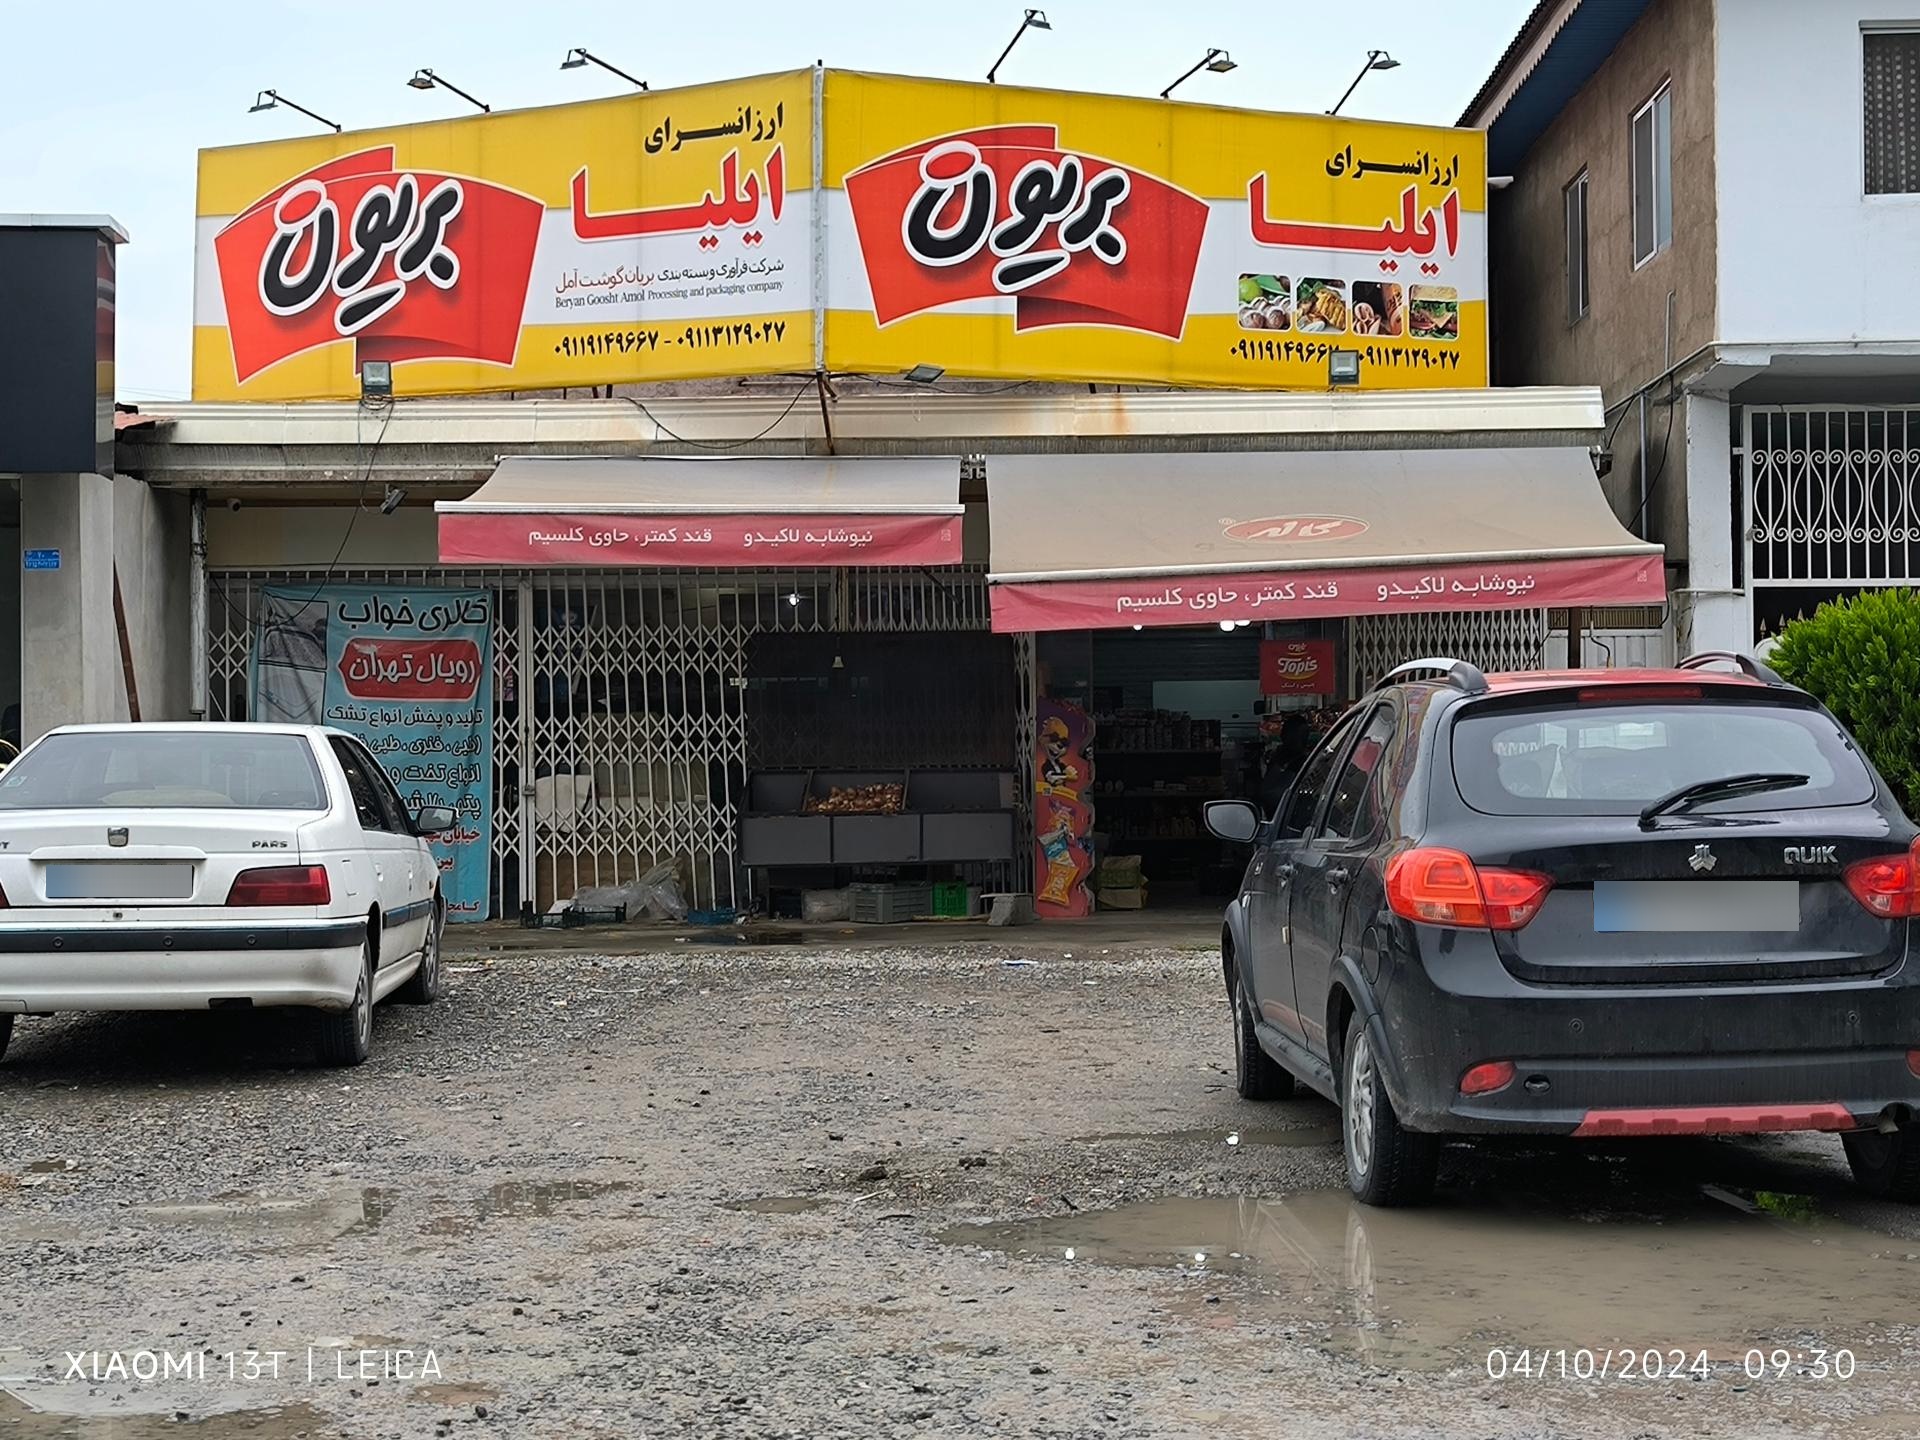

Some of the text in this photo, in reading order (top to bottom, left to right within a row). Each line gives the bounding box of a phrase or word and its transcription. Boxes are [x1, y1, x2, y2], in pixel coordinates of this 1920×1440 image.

[571, 143, 787, 250] ایلیا
[1247, 170, 1461, 275] ایلیا
[624, 265, 655, 287] بریان
[716, 257, 748, 279] فرآوری
[749, 257, 785, 274] شرکت
[555, 268, 579, 293] آمل
[579, 265, 625, 290] گوشت
[555, 279, 784, 310] Beryan Goosht Amol Processing and packaging company
[554, 329, 659, 357] ۰۹۱۱۹۱۴۹۶۶۷
[677, 321, 786, 349] ۰۹۱۱۳۱۲۹۰۲۷
[528, 527, 585, 546] کلسیم
[589, 527, 630, 547] حاوی
[683, 527, 713, 543] قند
[744, 528, 800, 546] لاکیدو
[1116, 587, 1184, 613] کلسیم
[1189, 586, 1239, 610] حاوی
[1302, 581, 1339, 599] قند
[1376, 576, 1445, 602] لاکیدو
[338, 594, 416, 630] خواب
[349, 648, 414, 684] تهران
[415, 652, 477, 684] رویال
[1277, 655, 1319, 676] Topis
[327, 704, 367, 723] تشک
[369, 708, 402, 728] انواع
[404, 706, 444, 730] پخش
[445, 711, 455, 728] و
[402, 764, 447, 781] تخت
[447, 762, 480, 788] انواع
[251, 840, 288, 849] PARS
[442, 825, 482, 845] خیابان
[1783, 845, 1839, 865] QUIK
